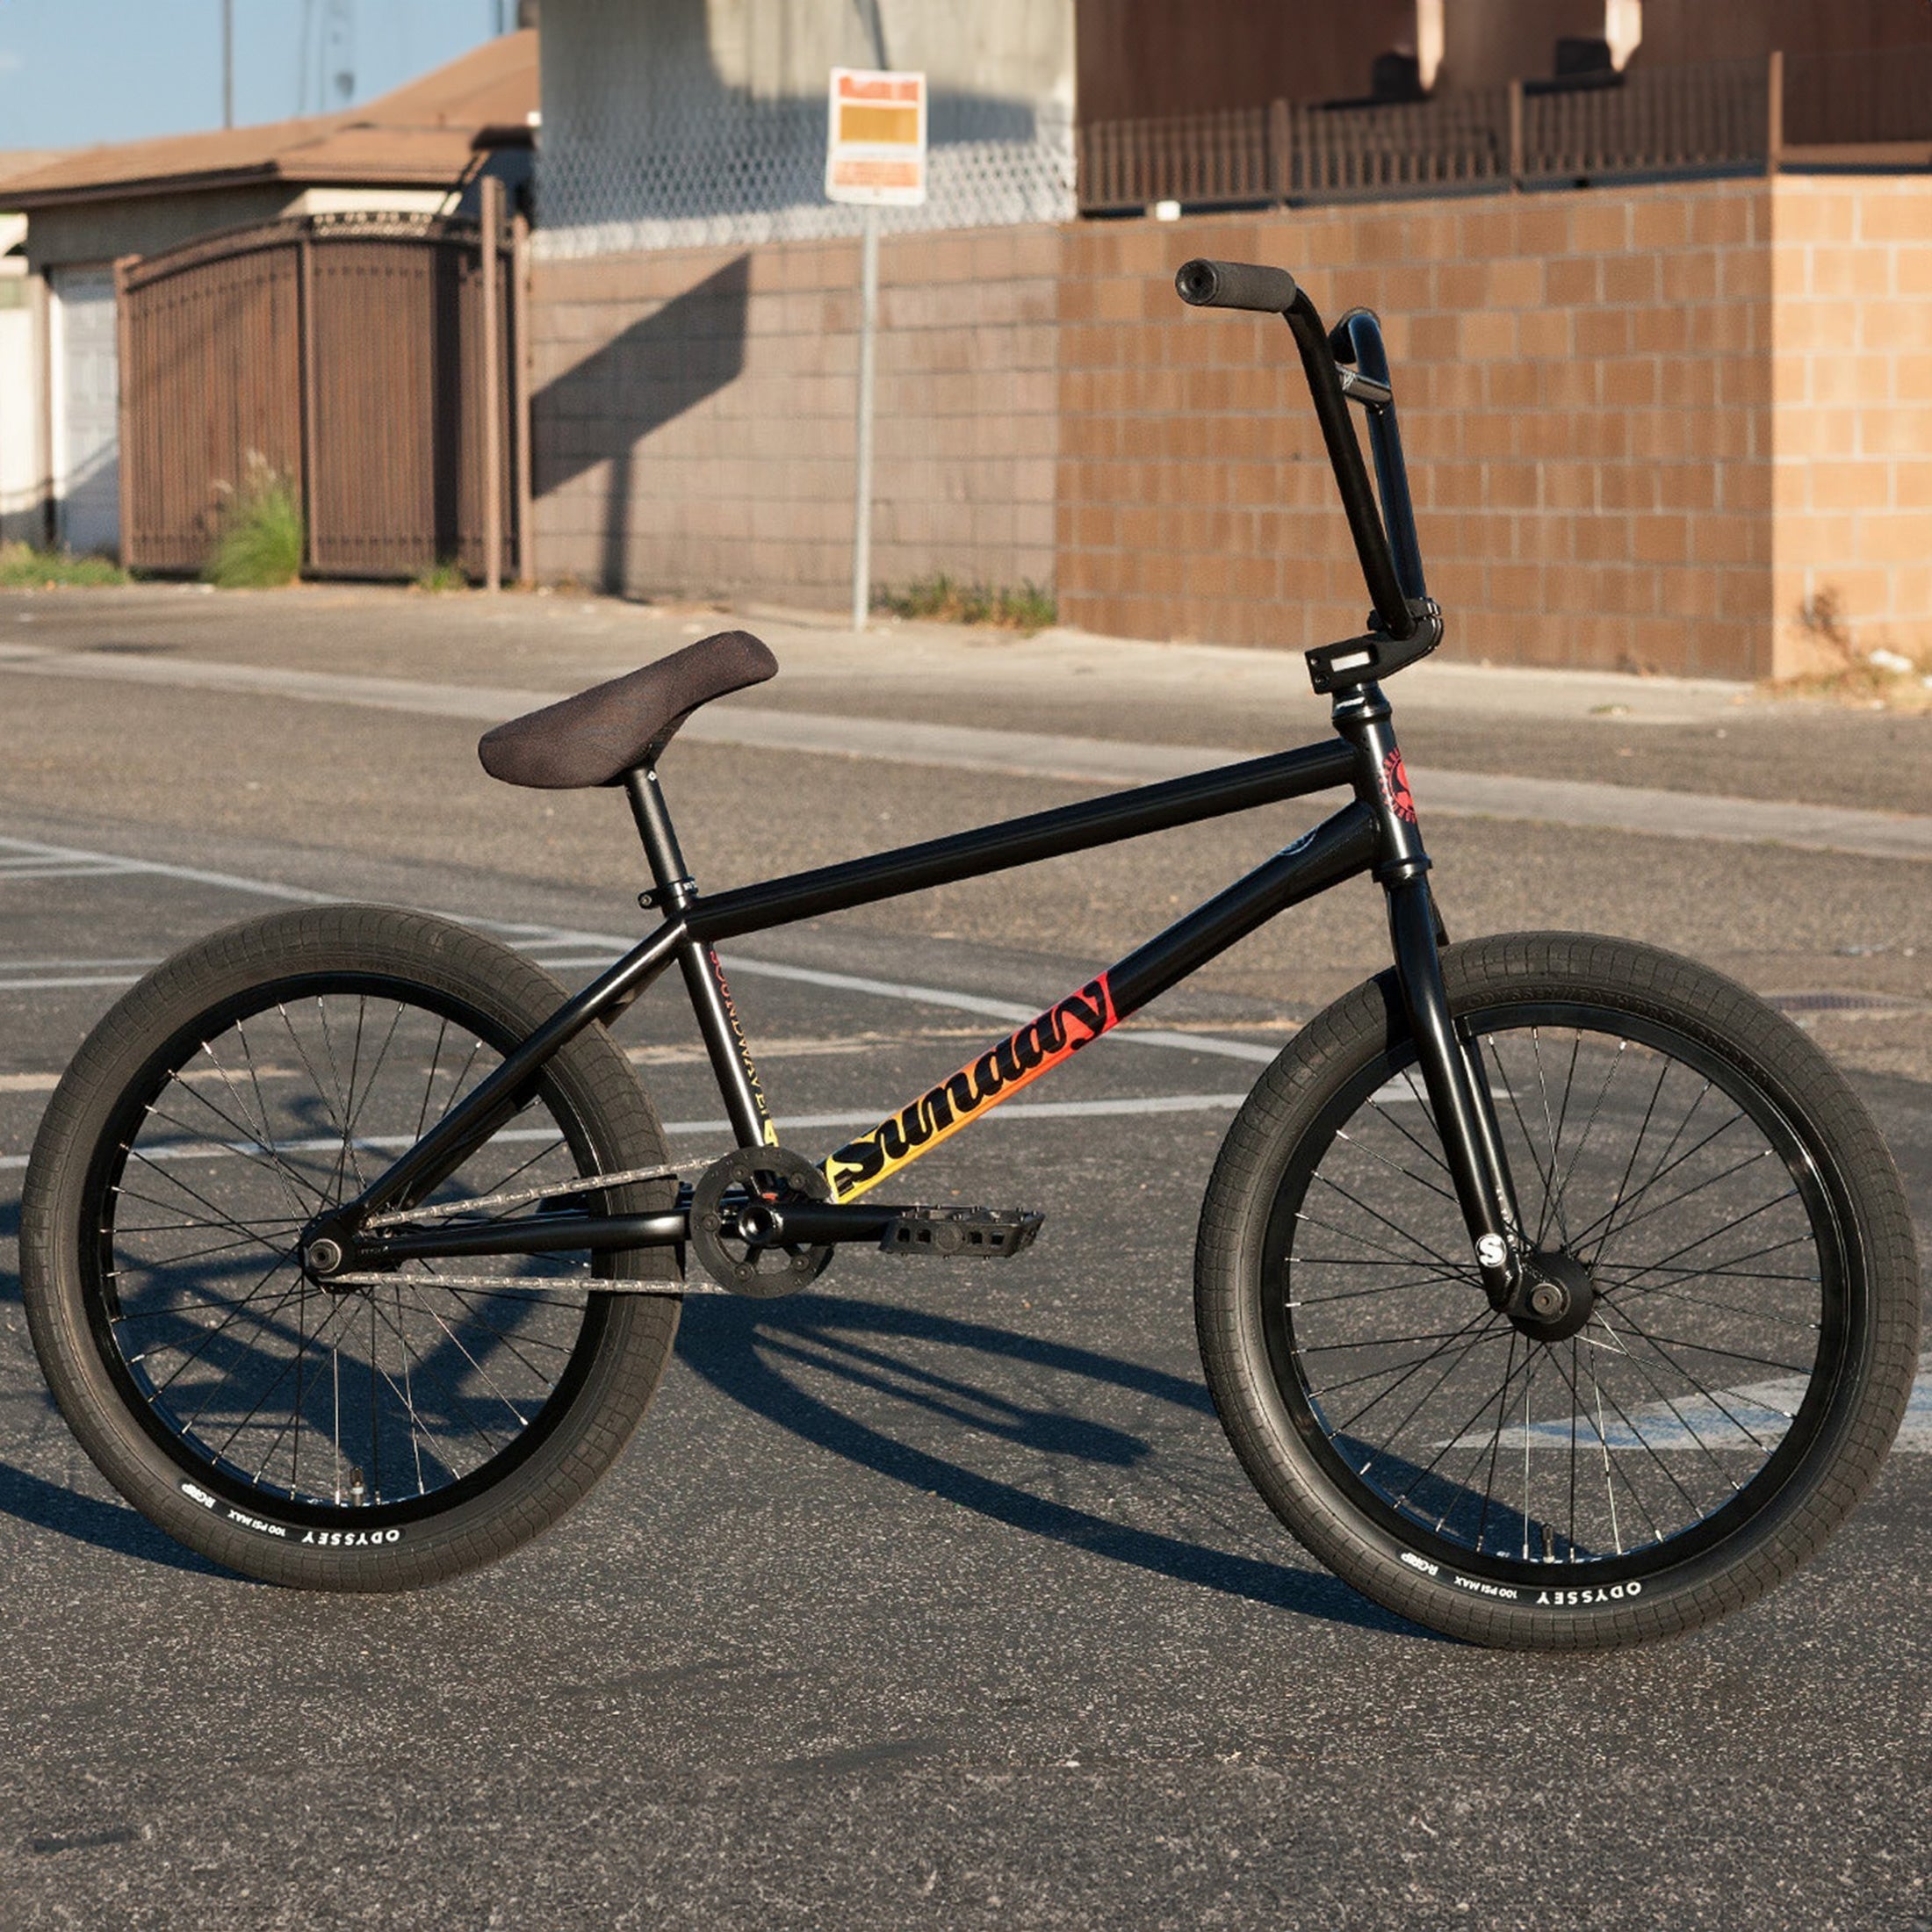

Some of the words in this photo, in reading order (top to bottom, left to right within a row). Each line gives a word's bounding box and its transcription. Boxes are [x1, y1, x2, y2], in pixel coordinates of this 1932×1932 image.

[833, 979, 1107, 1198] sunday
[227, 1509, 251, 1526] MAX
[251, 1519, 268, 1532] PSI
[267, 1525, 286, 1537] 100
[301, 1529, 400, 1546] ODYSSEY
[1453, 1575, 1480, 1590] MAX
[1481, 1583, 1498, 1596] PSI
[1498, 1588, 1517, 1599] 100
[1536, 1581, 1642, 1605] ODYSSEY
